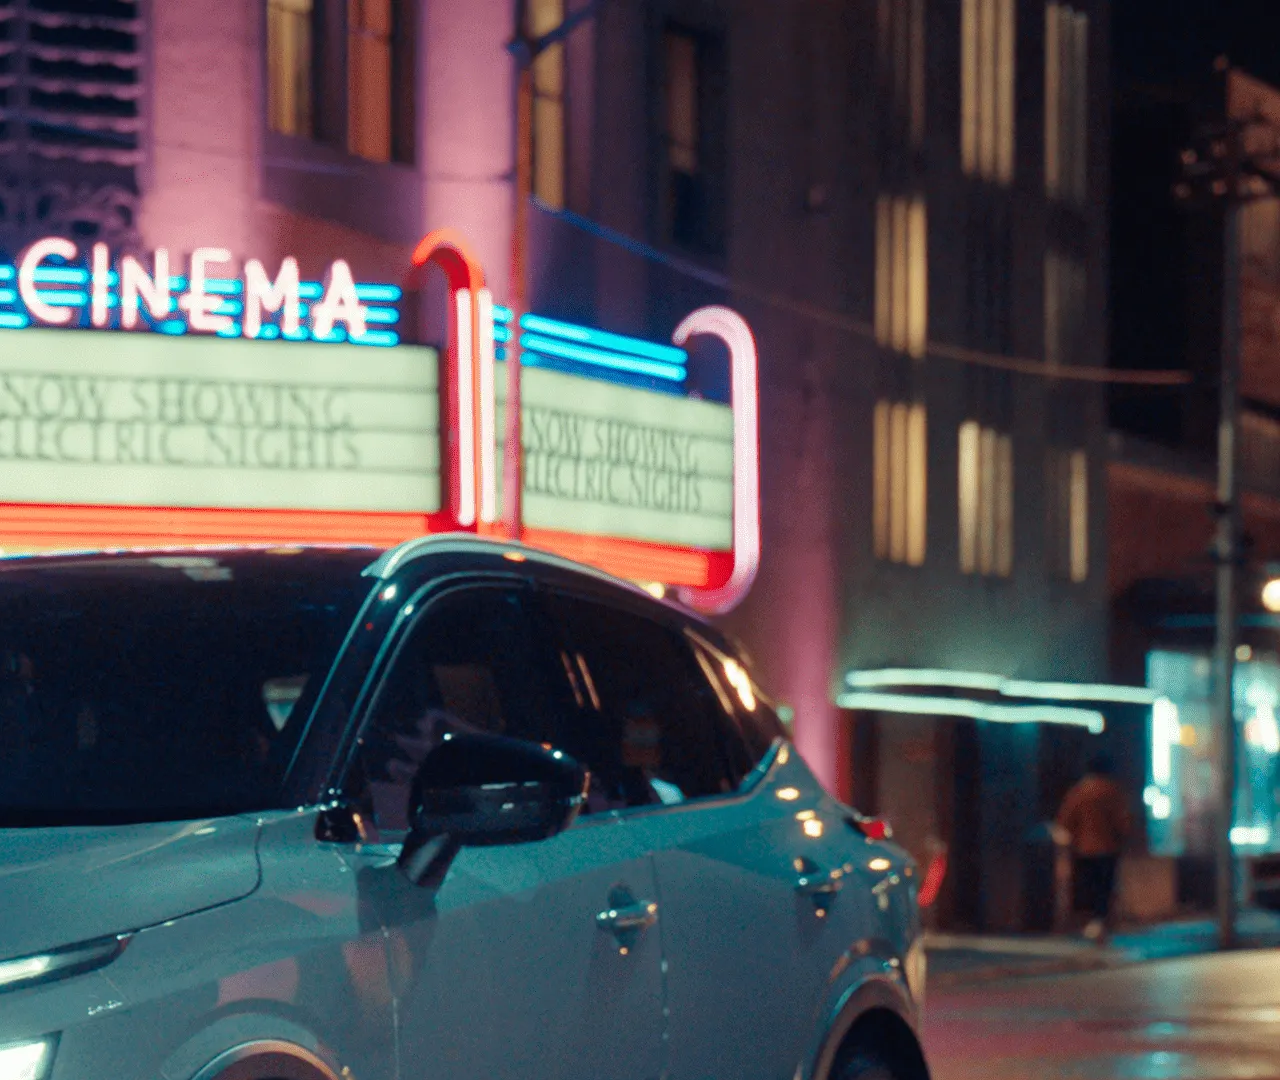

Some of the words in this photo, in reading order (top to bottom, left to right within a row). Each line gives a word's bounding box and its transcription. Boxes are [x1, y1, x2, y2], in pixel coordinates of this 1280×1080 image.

[18, 237, 368, 338] CINEMA
[0, 373, 112, 423] NOW
[130, 376, 353, 432] SHOWING
[203, 424, 362, 471] NIGHTS
[526, 407, 588, 458] NOW
[593, 417, 700, 475] SHOWING
[626, 462, 703, 513] NIGHTS
